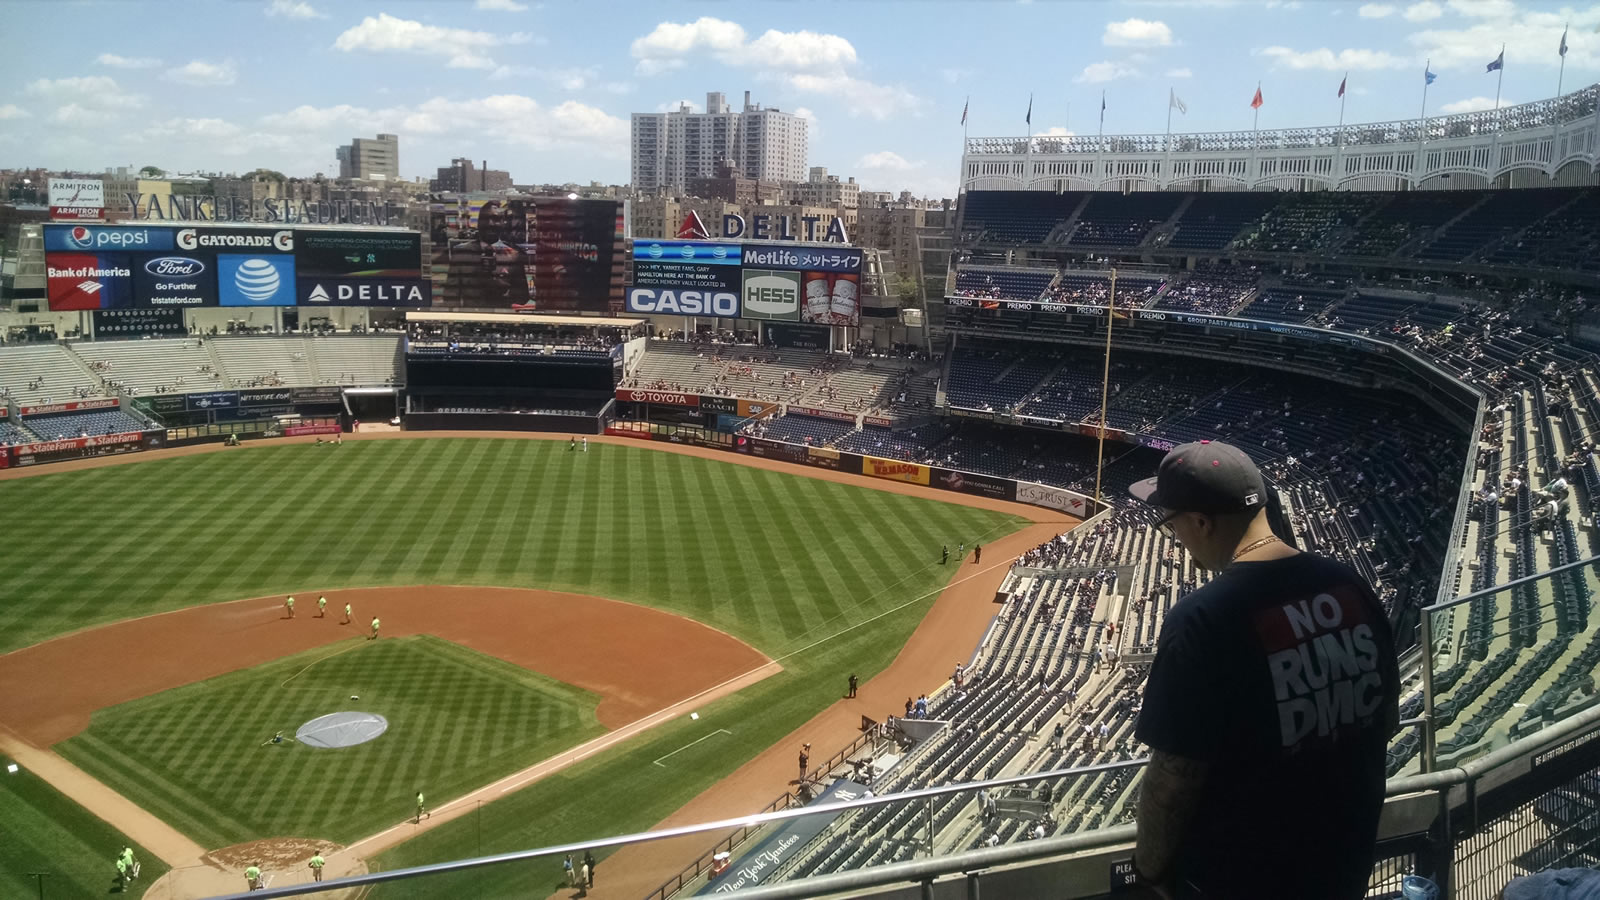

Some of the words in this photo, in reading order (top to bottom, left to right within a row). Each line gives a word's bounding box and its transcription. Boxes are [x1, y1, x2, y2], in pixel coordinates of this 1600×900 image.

[52, 183, 100, 191] ARMITRON
[125, 192, 246, 222] YANKEE
[263, 197, 390, 226] STADIUM
[723, 214, 848, 243] DELTA
[97, 229, 149, 247] pepsi
[199, 235, 272, 248] GATORADE
[744, 250, 799, 265] MetLife
[802, 254, 860, 268] メットライフ
[48, 267, 76, 278] Bank
[77, 267, 87, 278] of
[88, 266, 130, 278] America
[157, 259, 193, 274] Ford
[697, 280, 719, 288] LOCATED
[338, 285, 423, 300] DELTA
[747, 287, 795, 303] HESS
[151, 296, 203, 304] tristateford.com
[630, 288, 737, 315] CASIO
[949, 298, 972, 306] PREMIO
[1007, 302, 1032, 311] PREMIO
[1041, 304, 1067, 313] PREMIO
[1076, 306, 1104, 316] PREMIO
[1139, 311, 1166, 321] PREMIO
[1208, 319, 1228, 327] PARTY
[1228, 321, 1249, 329] AREAS
[647, 393, 686, 404] TOYOTA
[702, 402, 734, 411] COACH
[1020, 488, 1038, 499] U.S.
[1039, 491, 1069, 506] TRUST
[1283, 593, 1343, 639] NO
[1268, 623, 1378, 701] RUNS
[1276, 671, 1384, 748] DMC
[1535, 755, 1542, 766] BE
[1542, 749, 1555, 762] ALERT
[1555, 746, 1564, 757] FOR
[715, 875, 746, 894] New
[739, 858, 768, 883] York
[760, 834, 800, 865] Yankees
